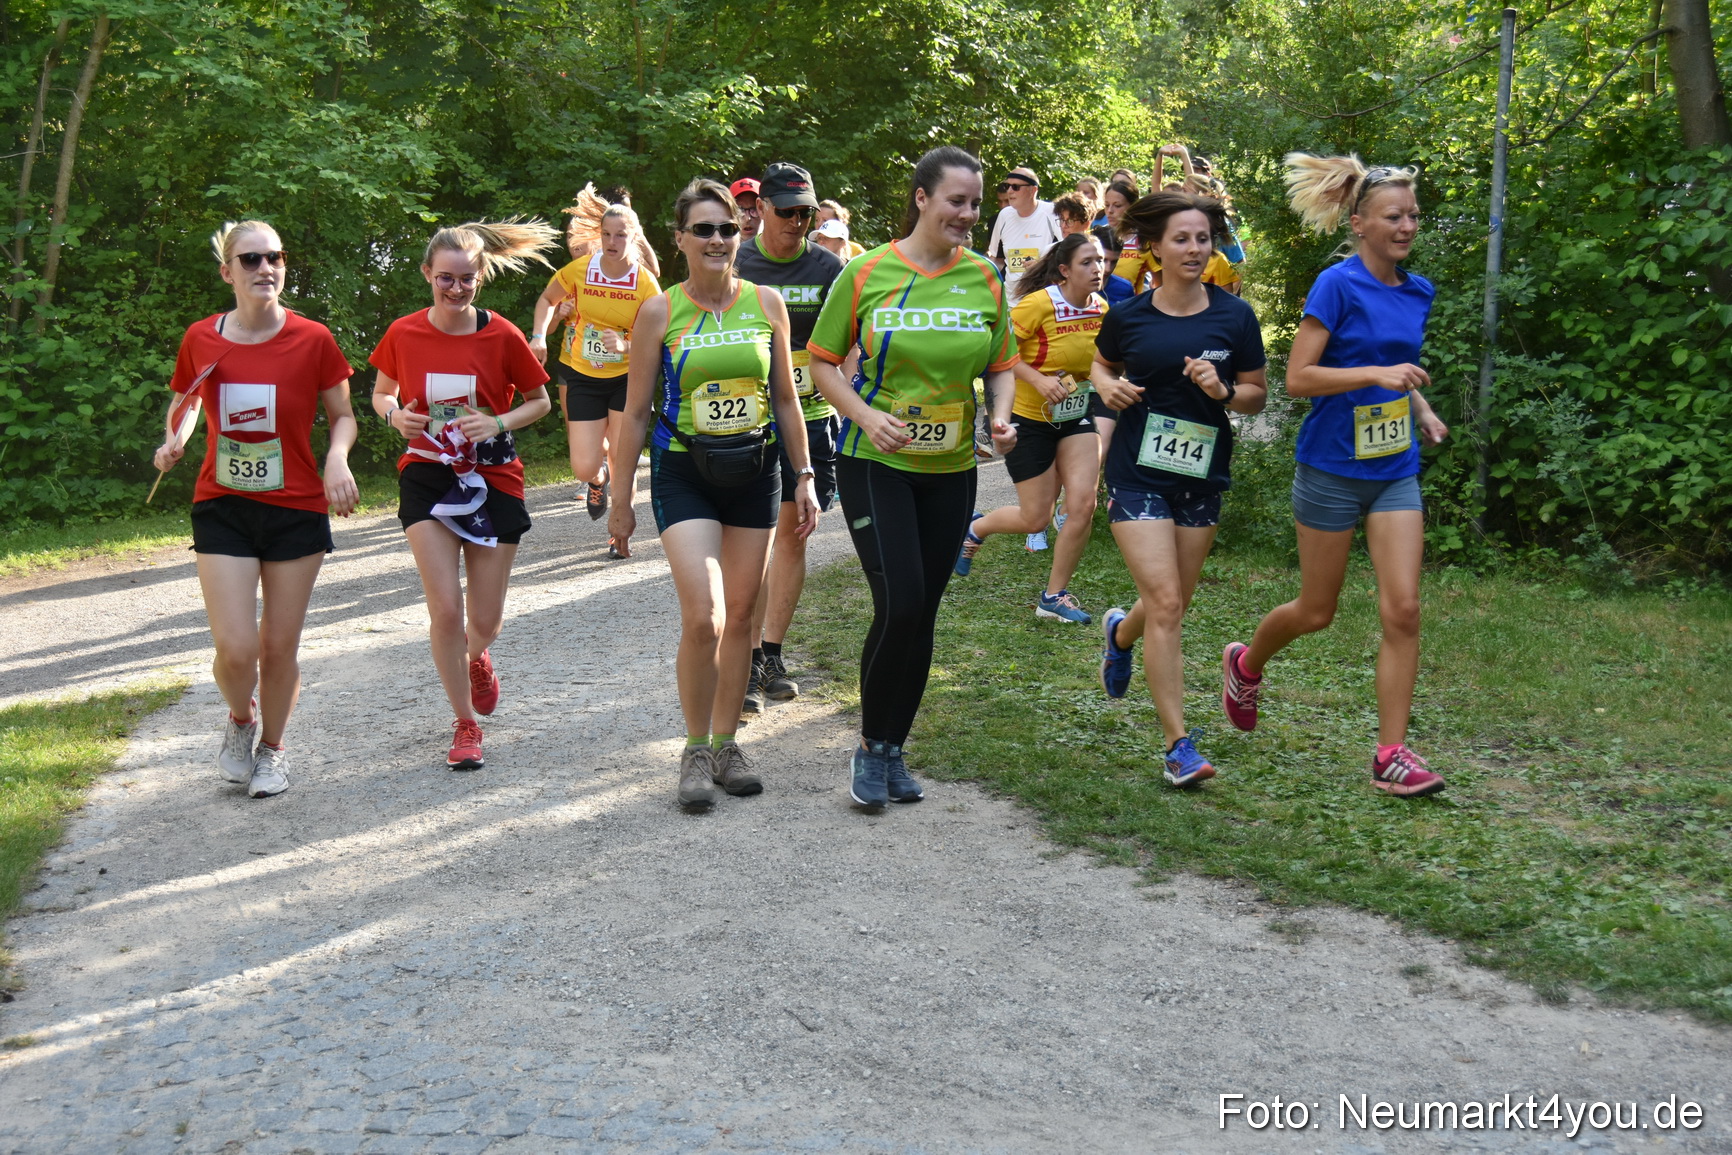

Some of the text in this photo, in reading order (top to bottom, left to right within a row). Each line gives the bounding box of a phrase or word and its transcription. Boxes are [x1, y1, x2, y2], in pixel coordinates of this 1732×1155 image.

[583, 288, 637, 301] MAX BÖGL
[872, 307, 986, 333] BOCK
[1055, 321, 1102, 335] MAX BÖG
[681, 328, 762, 350] BOCK
[708, 397, 748, 421] 322
[1060, 394, 1085, 412] 1678
[239, 411, 258, 421] DEHN
[905, 421, 947, 442] 329
[1364, 416, 1405, 444] 1131
[1152, 434, 1204, 463] 1414
[228, 457, 269, 478] 538
